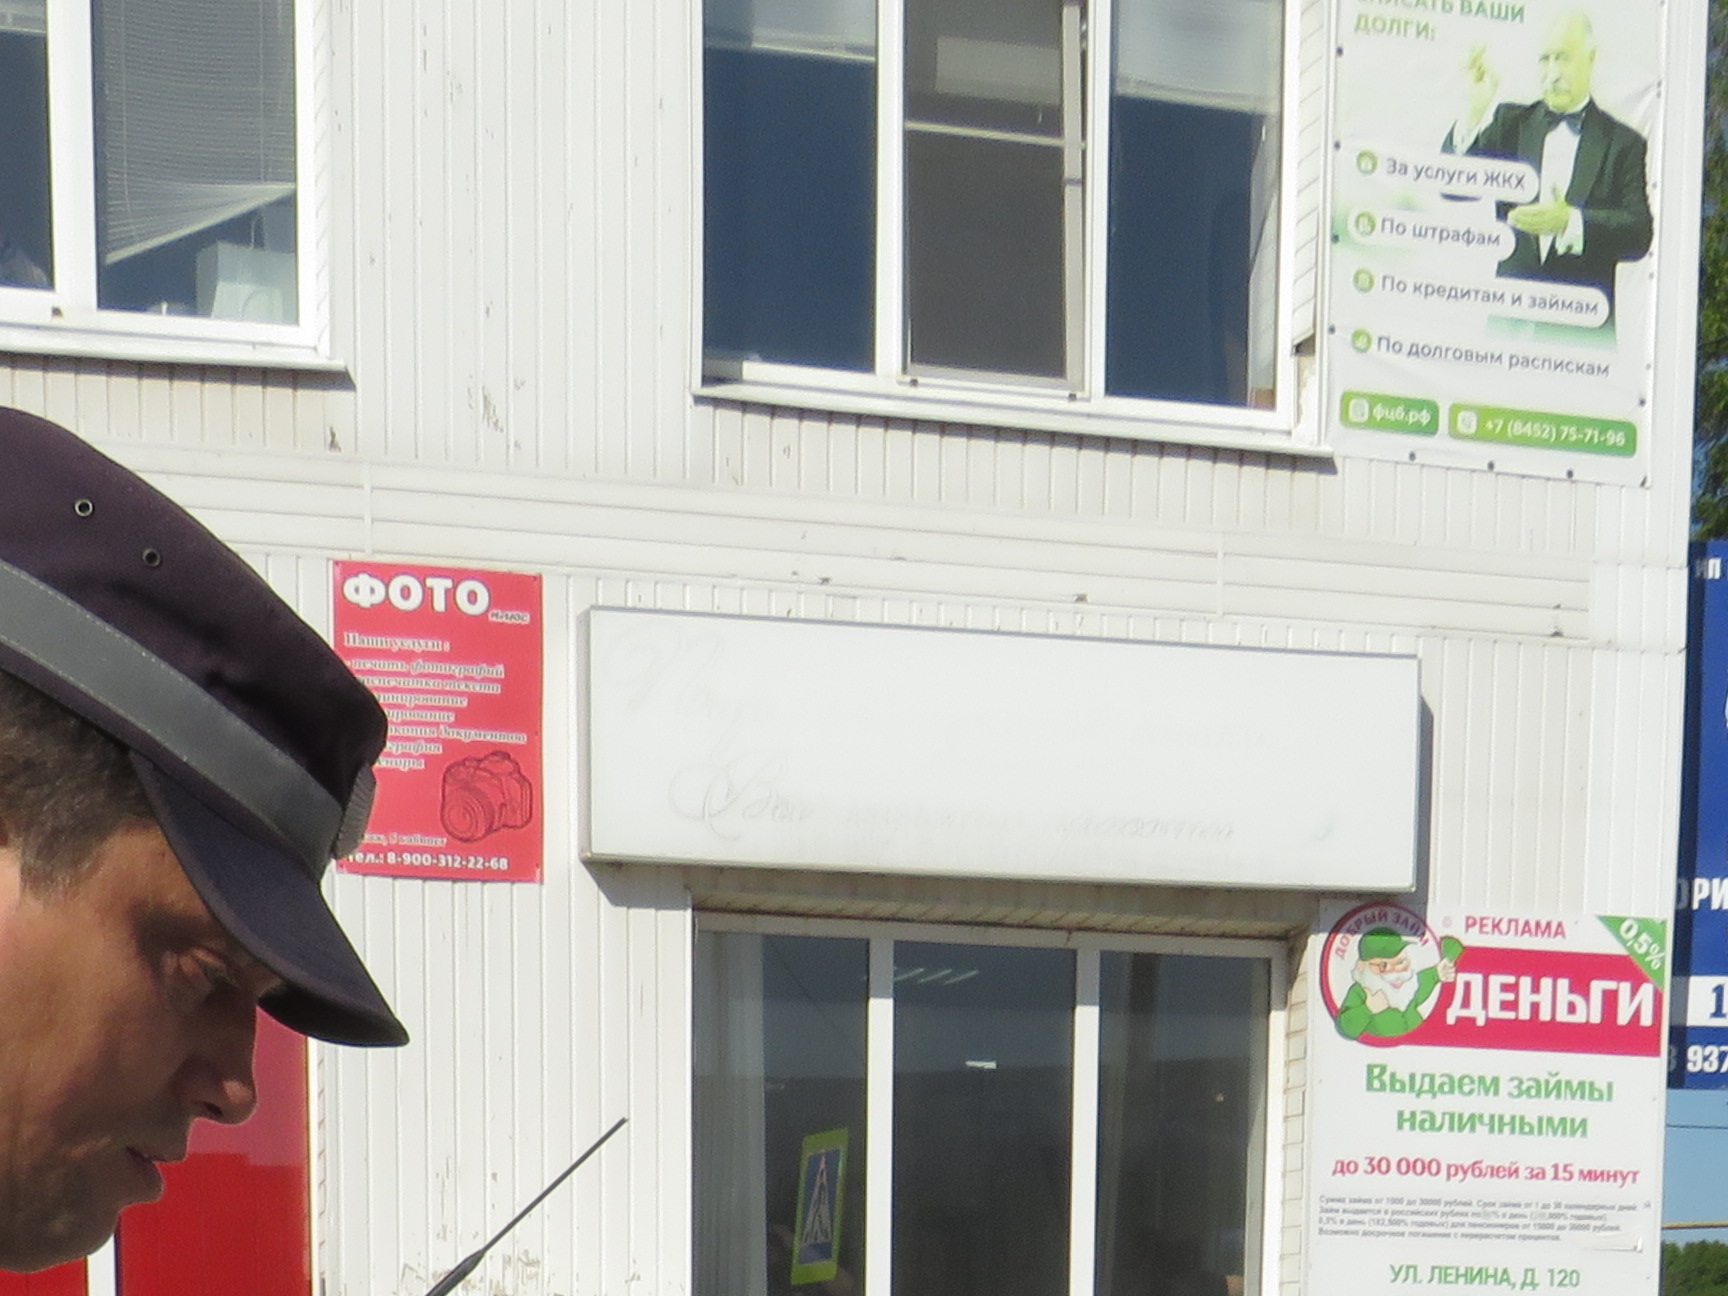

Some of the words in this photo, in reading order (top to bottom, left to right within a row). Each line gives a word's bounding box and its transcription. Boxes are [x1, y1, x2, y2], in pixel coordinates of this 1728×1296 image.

[1354, 13, 1435, 41] ДОЛГИ:
[1386, 157, 1408, 176] За
[1412, 164, 1478, 185] услуги
[1483, 170, 1526, 190] ЖКХ
[1380, 217, 1407, 236] По
[1412, 224, 1501, 248] штрафам
[1381, 275, 1407, 293] По
[1413, 281, 1506, 305] кредитам
[1511, 293, 1522, 306] и
[1527, 293, 1600, 316] займам
[1376, 335, 1404, 354] По
[1407, 342, 1503, 367] долговым
[1508, 353, 1611, 378] распискам
[1484, 417, 1504, 434] +7
[342, 572, 491, 617] ФОТО
[386, 851, 509, 870] 8-900-312-22-68
[1464, 916, 1566, 940] РЕКЛАМА
[1619, 917, 1664, 971] 0,5%
[1445, 972, 1655, 1028] ДЕНЬГИ
[1709, 983, 1728, 1019] 1
[1365, 1063, 1501, 1099] Выдаем
[1507, 1072, 1615, 1103] займы
[1396, 1109, 1589, 1139] наличными
[1331, 1158, 1360, 1177] до
[1363, 1156, 1392, 1176] 30
[1396, 1158, 1442, 1177] 000
[1445, 1160, 1520, 1184] рублей
[1524, 1165, 1547, 1181] за
[1551, 1163, 1574, 1182] 15
[1577, 1168, 1641, 1188] минут
[1389, 1264, 1422, 1284] УЛ.
[1427, 1265, 1516, 1290] ЛЕНИНА,
[1548, 1268, 1580, 1287] 120
